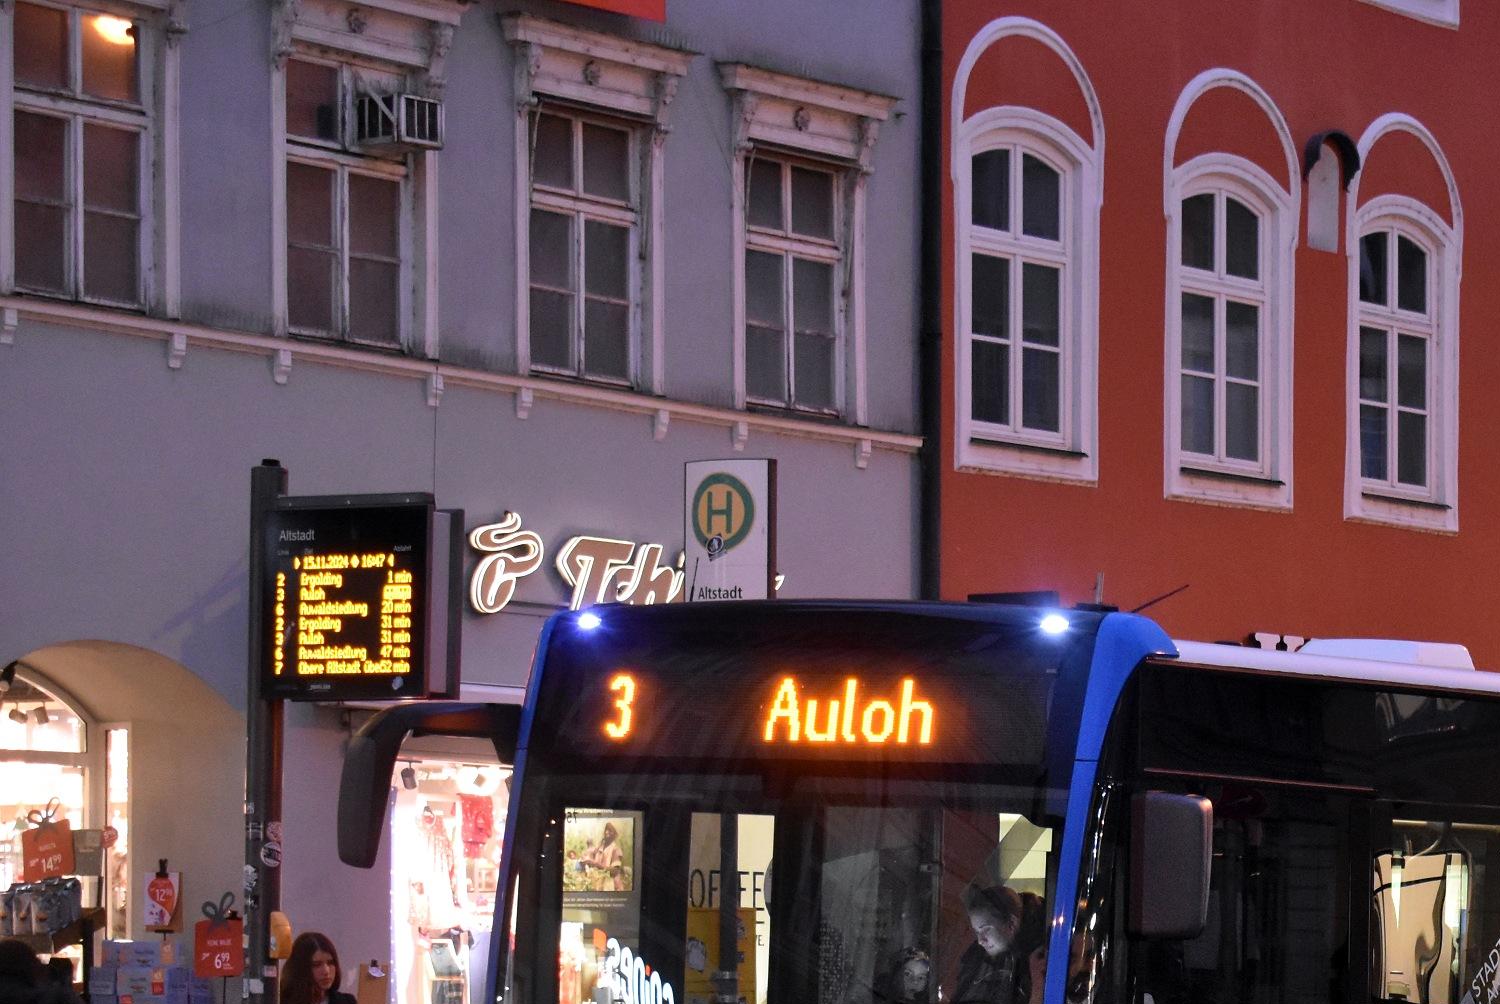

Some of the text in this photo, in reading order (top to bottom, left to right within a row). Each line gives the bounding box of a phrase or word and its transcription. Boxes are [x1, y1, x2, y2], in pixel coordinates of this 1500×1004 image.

[706, 490, 733, 534] H
[280, 529, 315, 542] Altstadt
[276, 573, 285, 587] 2
[300, 572, 342, 588] Ergolding
[394, 570, 412, 584] min
[276, 588, 285, 601] 3
[698, 585, 742, 600] Altstadt
[275, 603, 284, 617] 6
[393, 600, 412, 613] min
[275, 614, 411, 632] 2 Ergolding 31 min
[275, 632, 284, 646] 3
[380, 630, 392, 643] 31
[393, 630, 411, 643] min
[275, 647, 284, 661] 6
[380, 645, 391, 658] 47
[392, 644, 410, 658] min
[274, 662, 283, 675] 7
[393, 659, 410, 673] min
[605, 676, 934, 744] 3 Auloh
